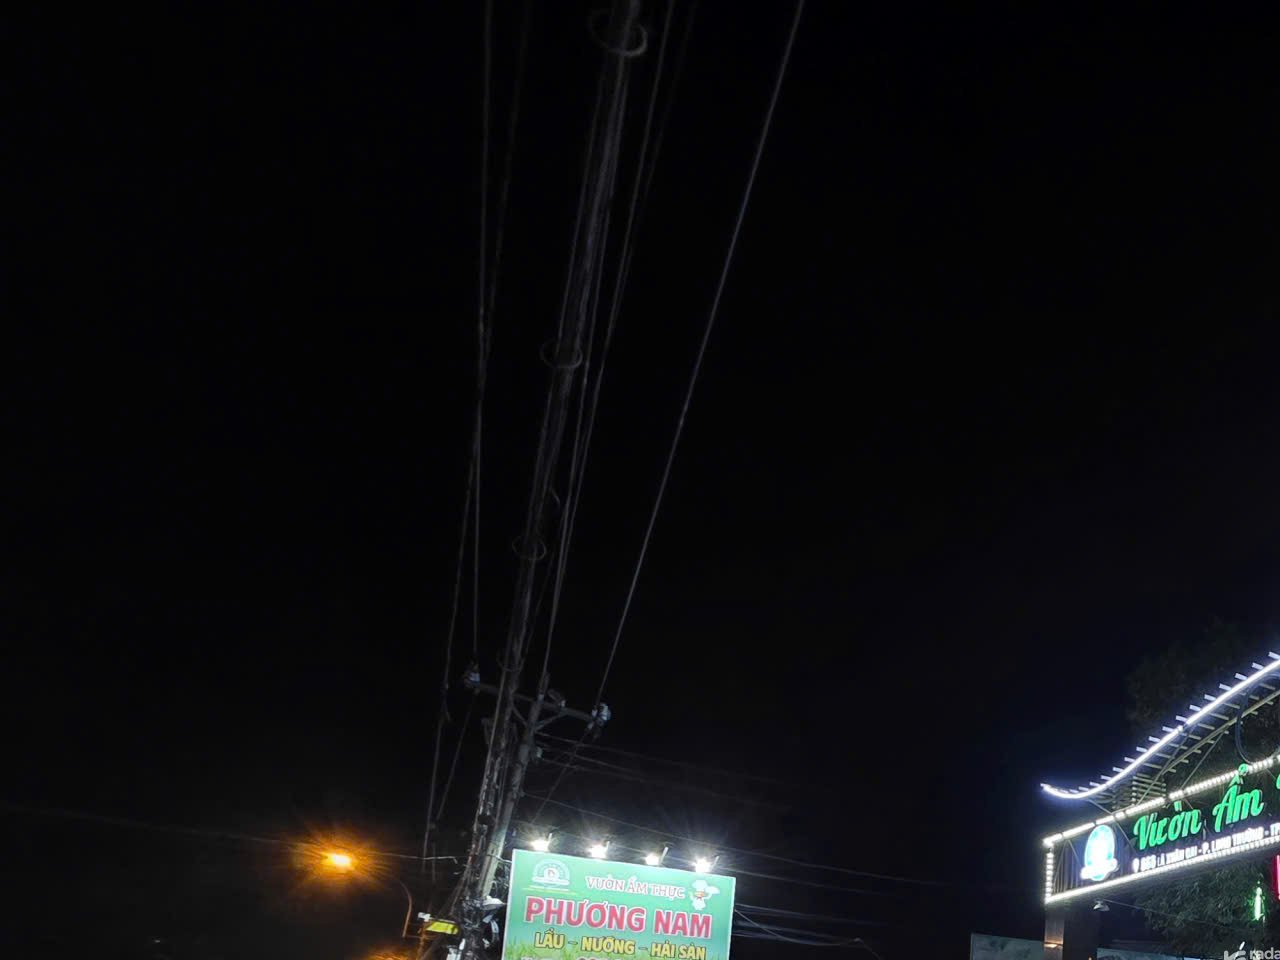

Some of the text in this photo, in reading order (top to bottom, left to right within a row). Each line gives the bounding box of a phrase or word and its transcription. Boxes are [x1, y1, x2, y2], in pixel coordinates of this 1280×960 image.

[1133, 800, 1203, 850] Vườn
[525, 897, 712, 938] PHƯƠNG NAM
